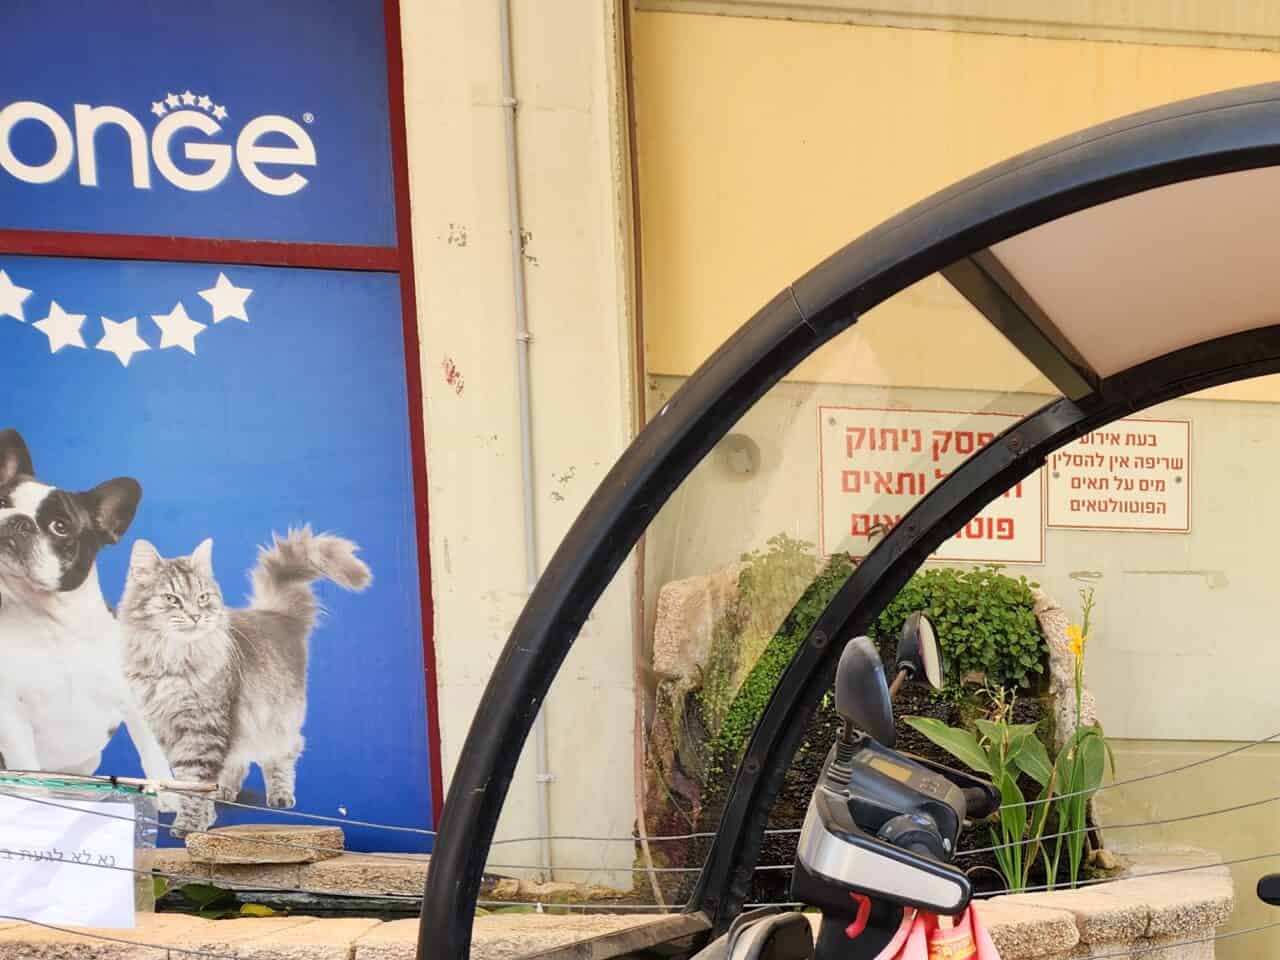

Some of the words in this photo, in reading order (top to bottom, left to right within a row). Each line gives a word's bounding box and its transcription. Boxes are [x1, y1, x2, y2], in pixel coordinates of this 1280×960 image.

[845, 427, 922, 458] ניתוק
[932, 431, 995, 462] פסק
[1125, 432, 1157, 446] בעת
[1109, 455, 1129, 472] אין
[1134, 455, 1183, 470] שריפה
[841, 469, 925, 495] ותאים
[1071, 476, 1109, 490] תאים
[1113, 475, 1134, 490] על
[1139, 478, 1165, 492] מים
[71, 848, 91, 863] לא
